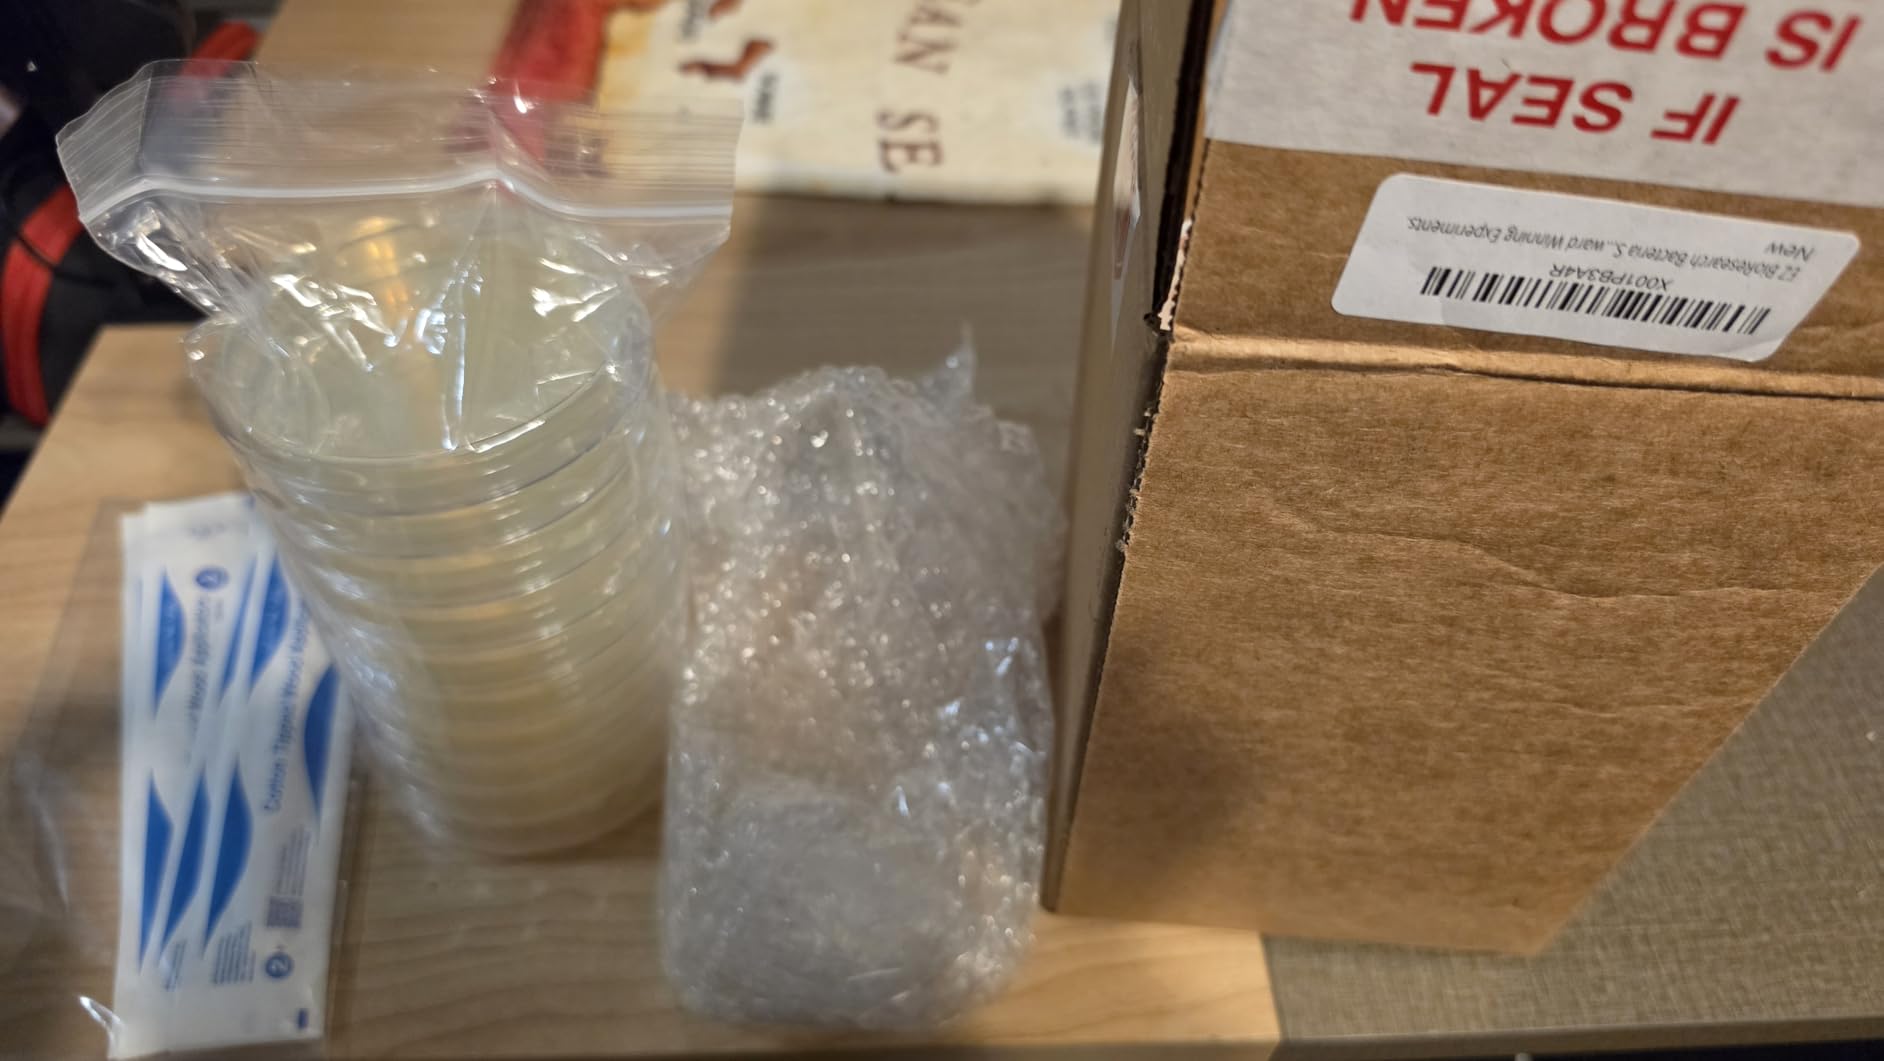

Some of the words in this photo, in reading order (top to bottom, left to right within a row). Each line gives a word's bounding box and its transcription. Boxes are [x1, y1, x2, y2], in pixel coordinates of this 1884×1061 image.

[1764, 11, 1862, 72] IS
[1410, 62, 1634, 133] SEAL
[1651, 93, 1740, 145] IF
[1503, 223, 1564, 249] Winning
[1627, 243, 1688, 268] Bacteria
[1763, 242, 1816, 262] New
[1549, 263, 1673, 291] X001PB3A4R
[1690, 253, 1779, 280] BioResearch
